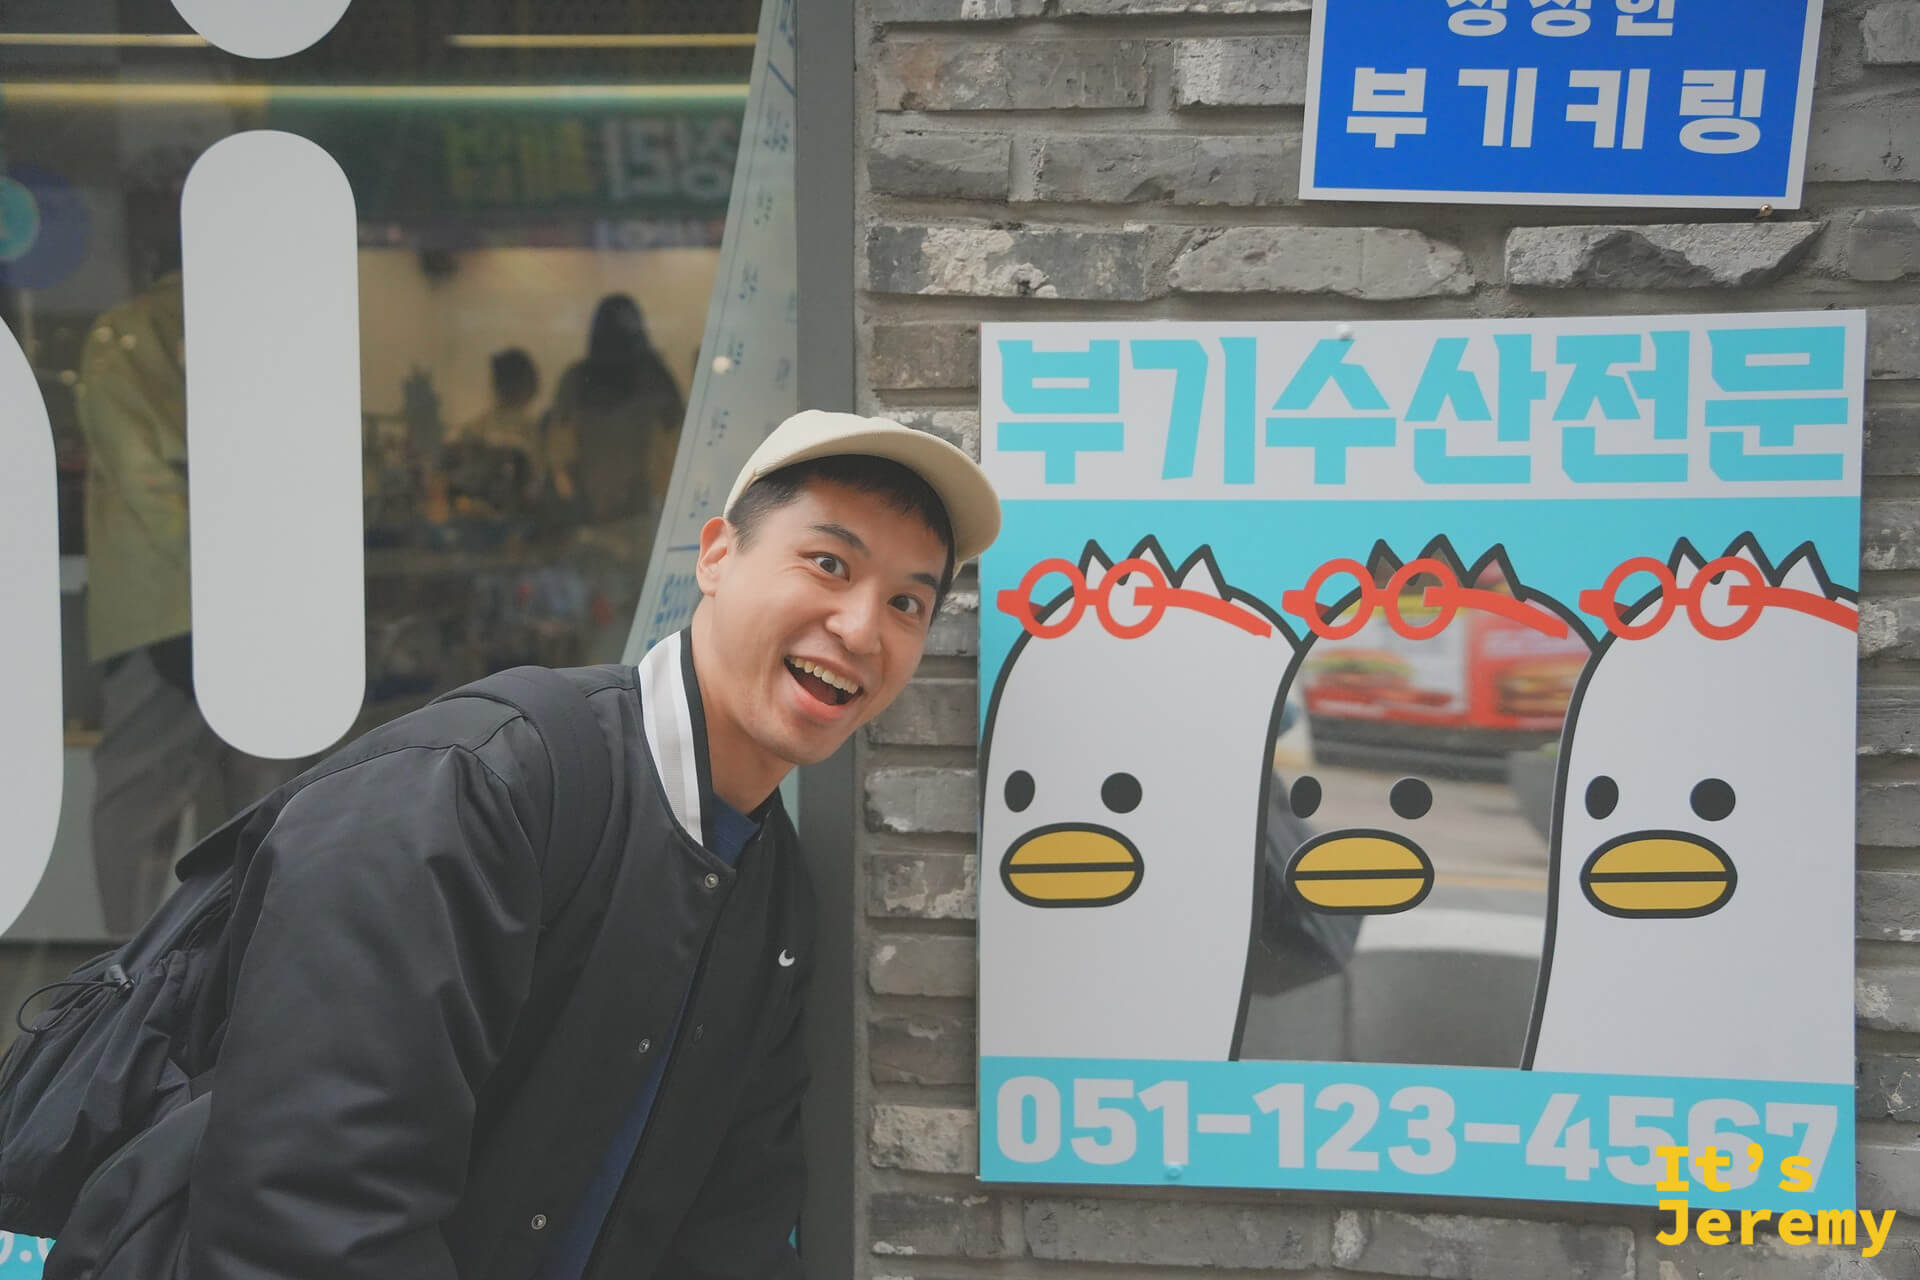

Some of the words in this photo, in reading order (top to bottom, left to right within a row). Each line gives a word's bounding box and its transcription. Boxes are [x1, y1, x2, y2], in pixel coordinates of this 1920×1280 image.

[1346, 67, 1766, 155] 부기키링
[997, 325, 1849, 486] 부기수산전문
[996, 1075, 1839, 1194] 051-123-4567
